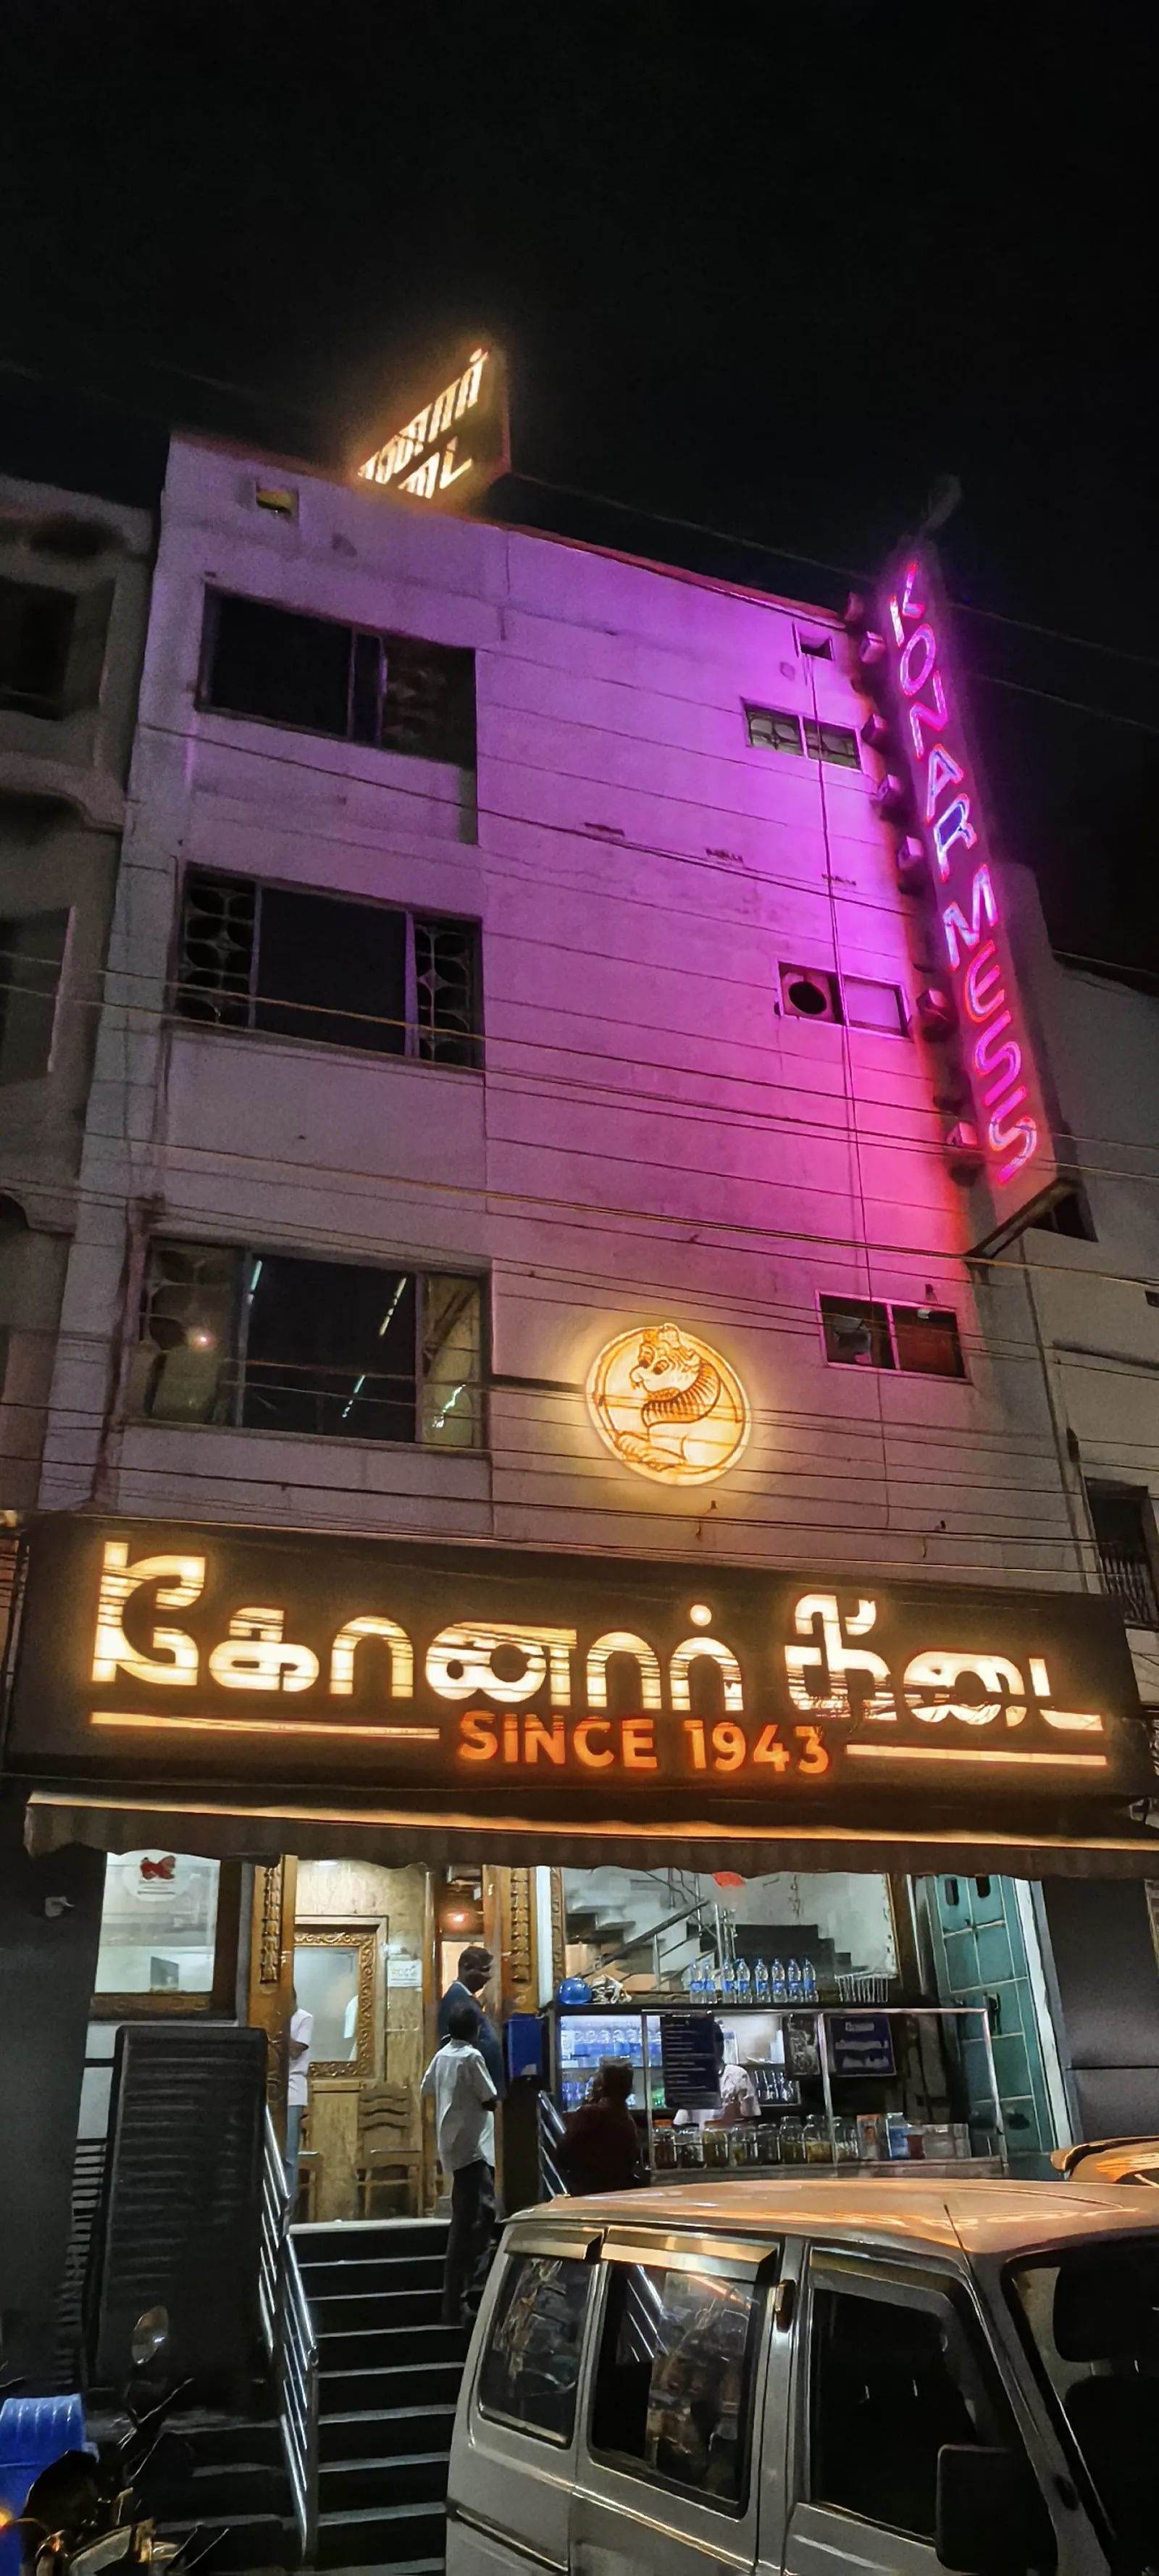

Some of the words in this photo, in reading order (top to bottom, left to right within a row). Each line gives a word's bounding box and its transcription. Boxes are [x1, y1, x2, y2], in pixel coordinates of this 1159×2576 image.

[889, 561, 978, 884] KONAR
[942, 864, 1037, 1185] MESS
[91, 1540, 744, 1713] கோனார்
[458, 1710, 658, 1769] SINCE
[683, 1718, 830, 1775] 1943
